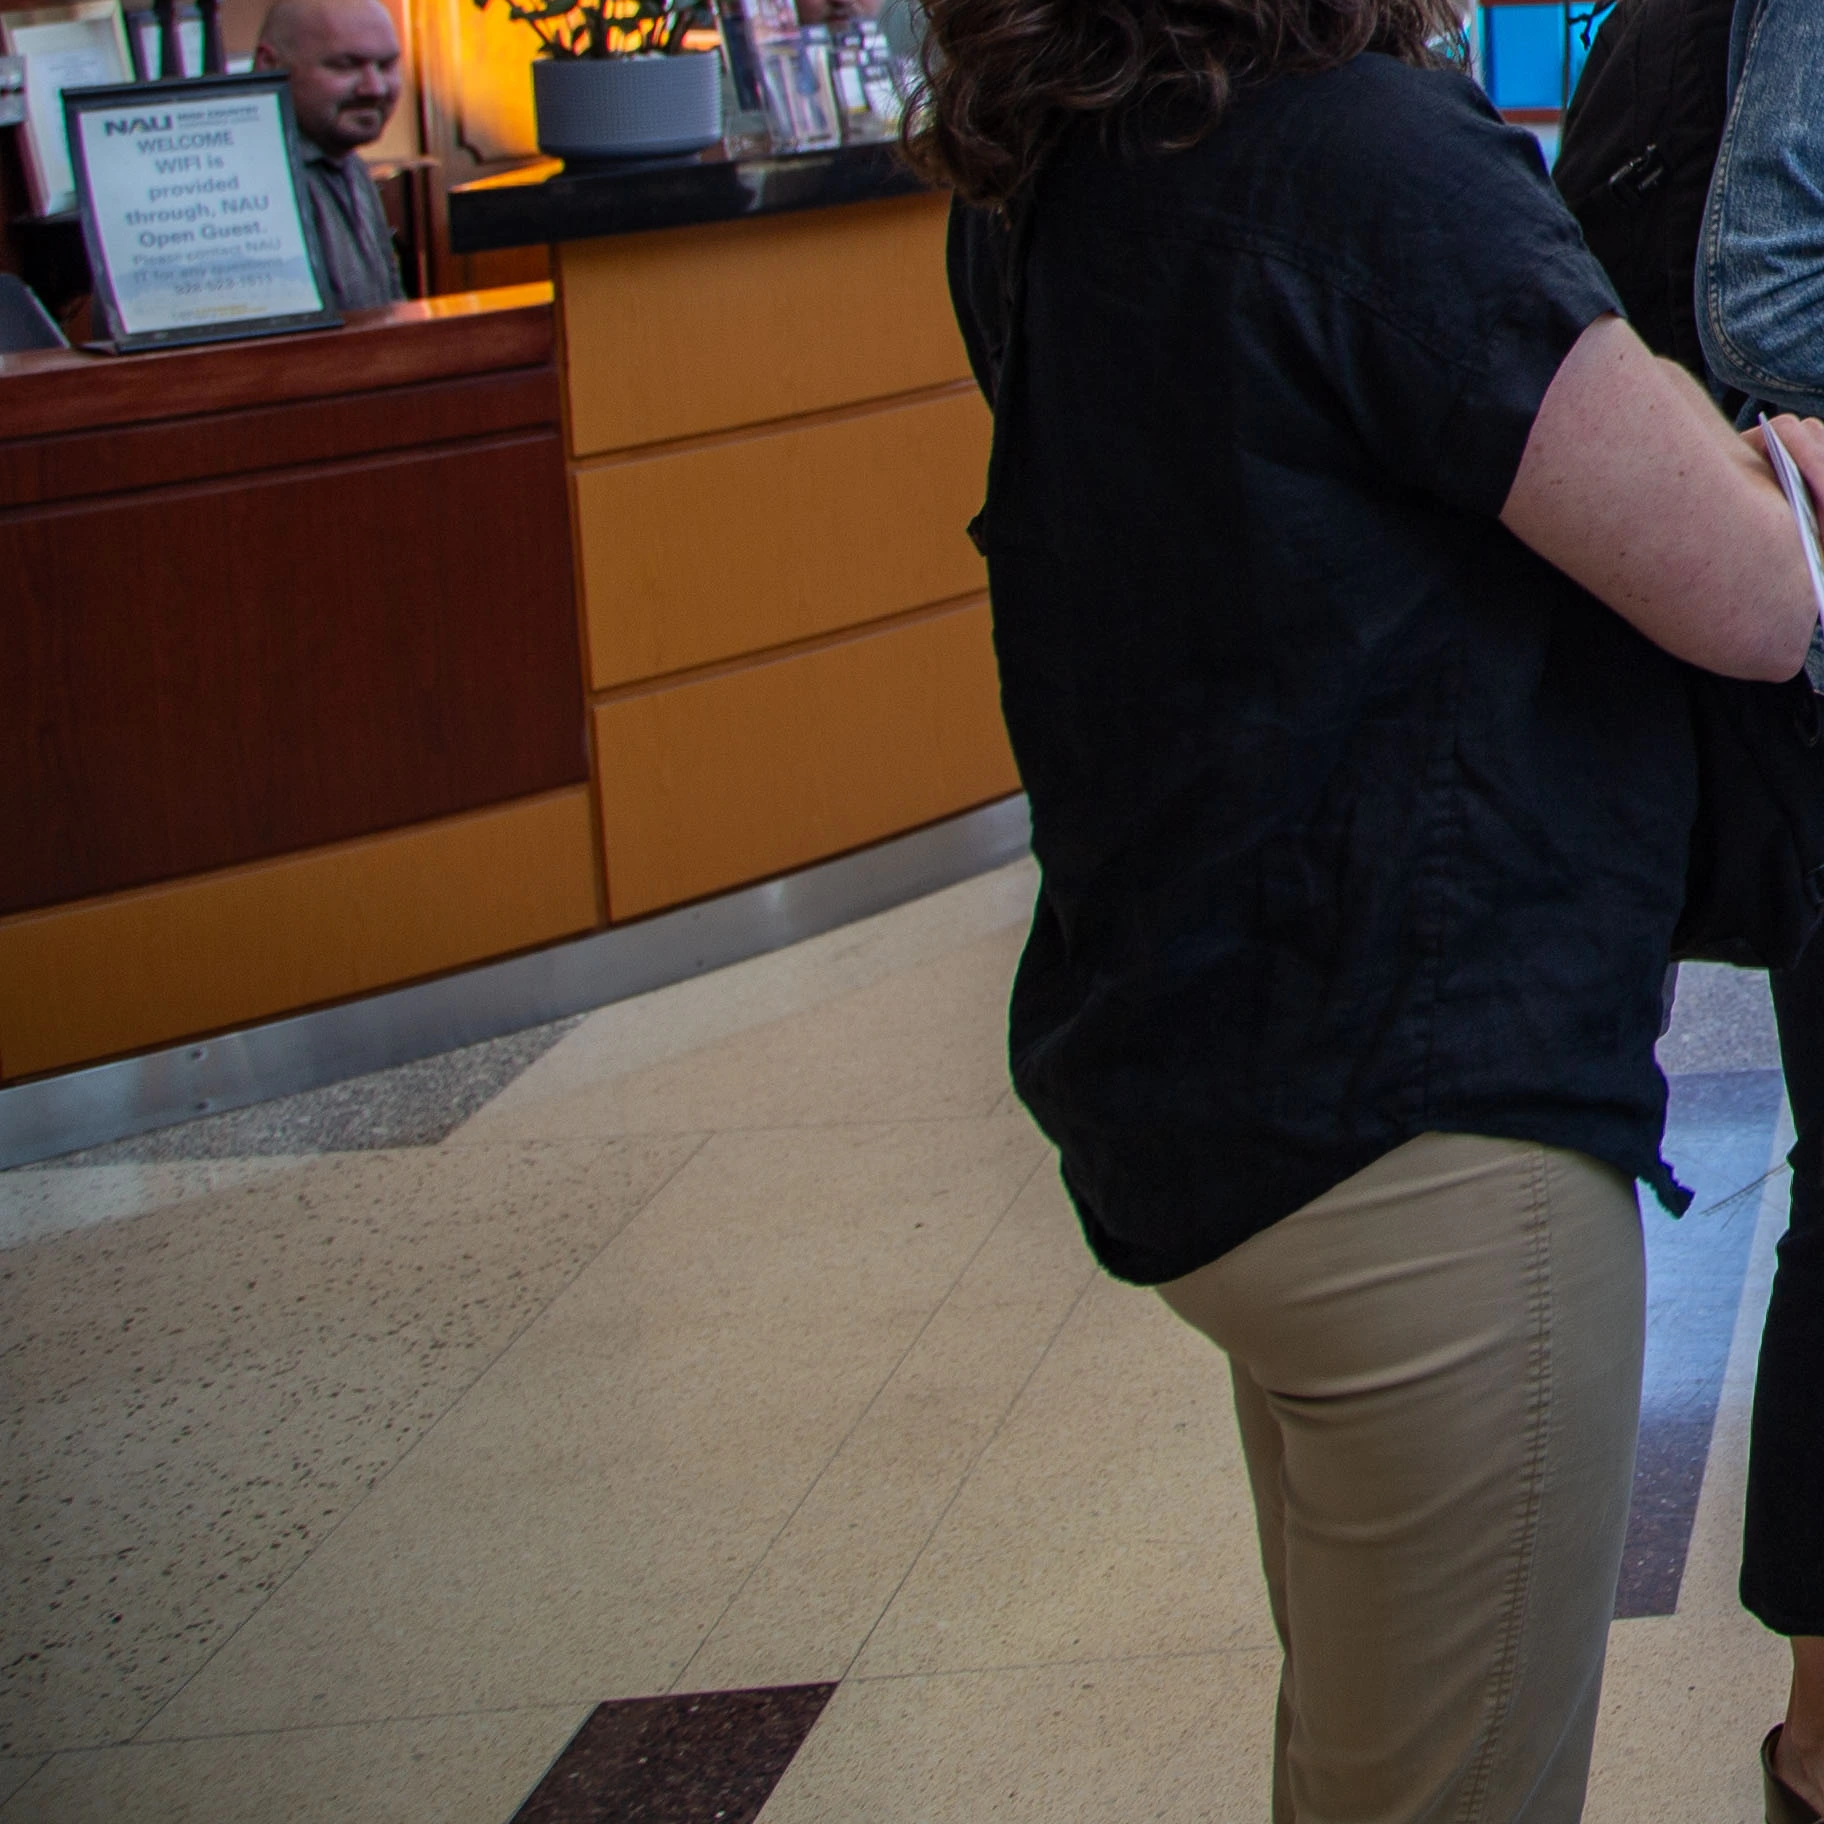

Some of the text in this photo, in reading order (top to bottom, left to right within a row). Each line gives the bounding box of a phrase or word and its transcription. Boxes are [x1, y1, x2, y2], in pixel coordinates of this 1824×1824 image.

[104, 115, 173, 136] NAU
[136, 131, 234, 154] WELCOME
[155, 153, 225, 174] WIFI is
[148, 177, 239, 202] provided
[125, 195, 269, 226] through, NAU
[139, 230, 195, 249] Open
